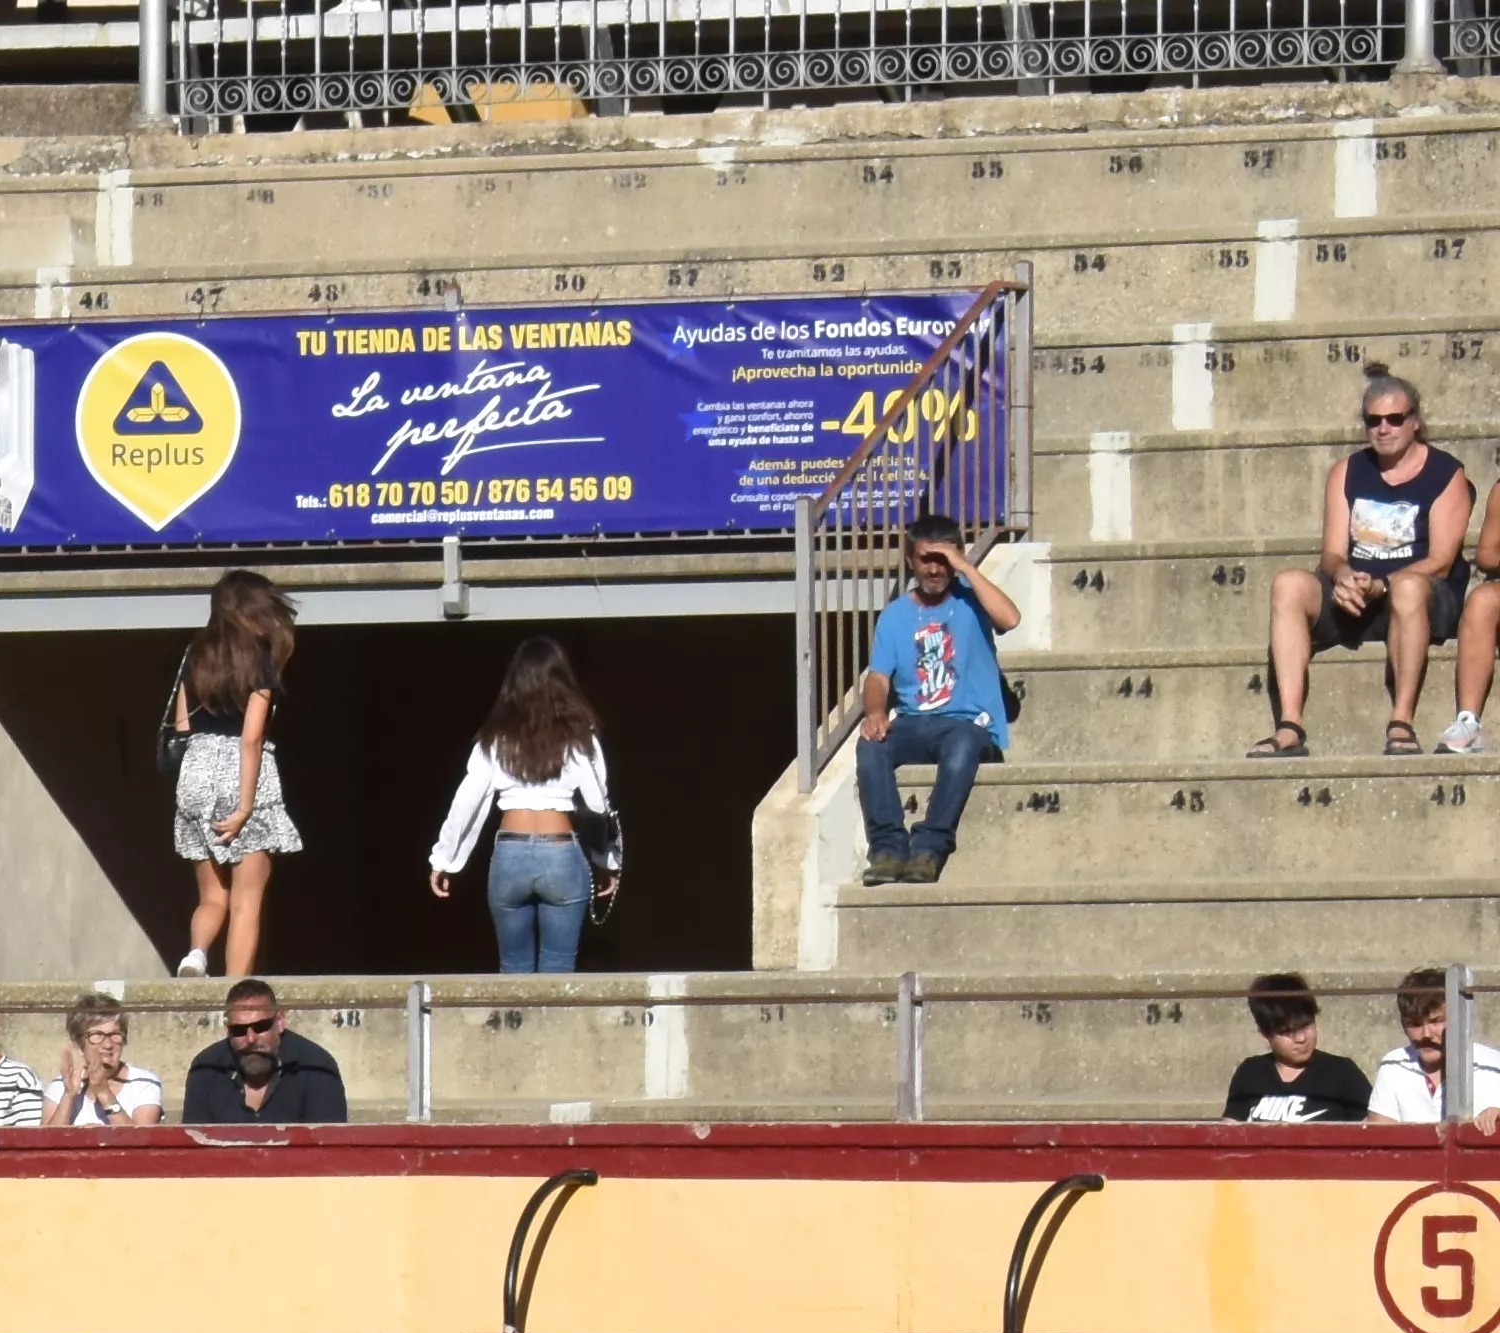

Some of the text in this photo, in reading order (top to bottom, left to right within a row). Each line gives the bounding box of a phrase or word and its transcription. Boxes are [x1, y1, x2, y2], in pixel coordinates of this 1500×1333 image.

[296, 321, 632, 356] TU TIENDA DE LAS VENTANAS
[672, 321, 747, 349] Ayudas
[751, 321, 776, 341] de
[780, 320, 810, 340] los
[814, 316, 892, 339] Fondos
[761, 344, 908, 360] Te tramitamos las ayudas.
[732, 364, 816, 384] ¡Aprovecha
[820, 363, 834, 377] la
[332, 359, 551, 418] La ventana
[732, 400, 745, 410] las
[746, 400, 786, 410] ventanas
[788, 399, 814, 409] ahora
[371, 381, 603, 476] perfecta
[801, 422, 814, 432] de
[111, 442, 205, 473] Replus
[748, 458, 797, 471] Además
[801, 457, 845, 472] puedes
[295, 476, 632, 509] Tels.: 618 70 70 50 / 876 54 56 09
[739, 474, 754, 486] de
[757, 475, 780, 485] una
[371, 508, 554, 524] comercial@replusventanas.com
[1252, 1094, 1307, 1122] NIKE
[1420, 1215, 1478, 1318] 5
